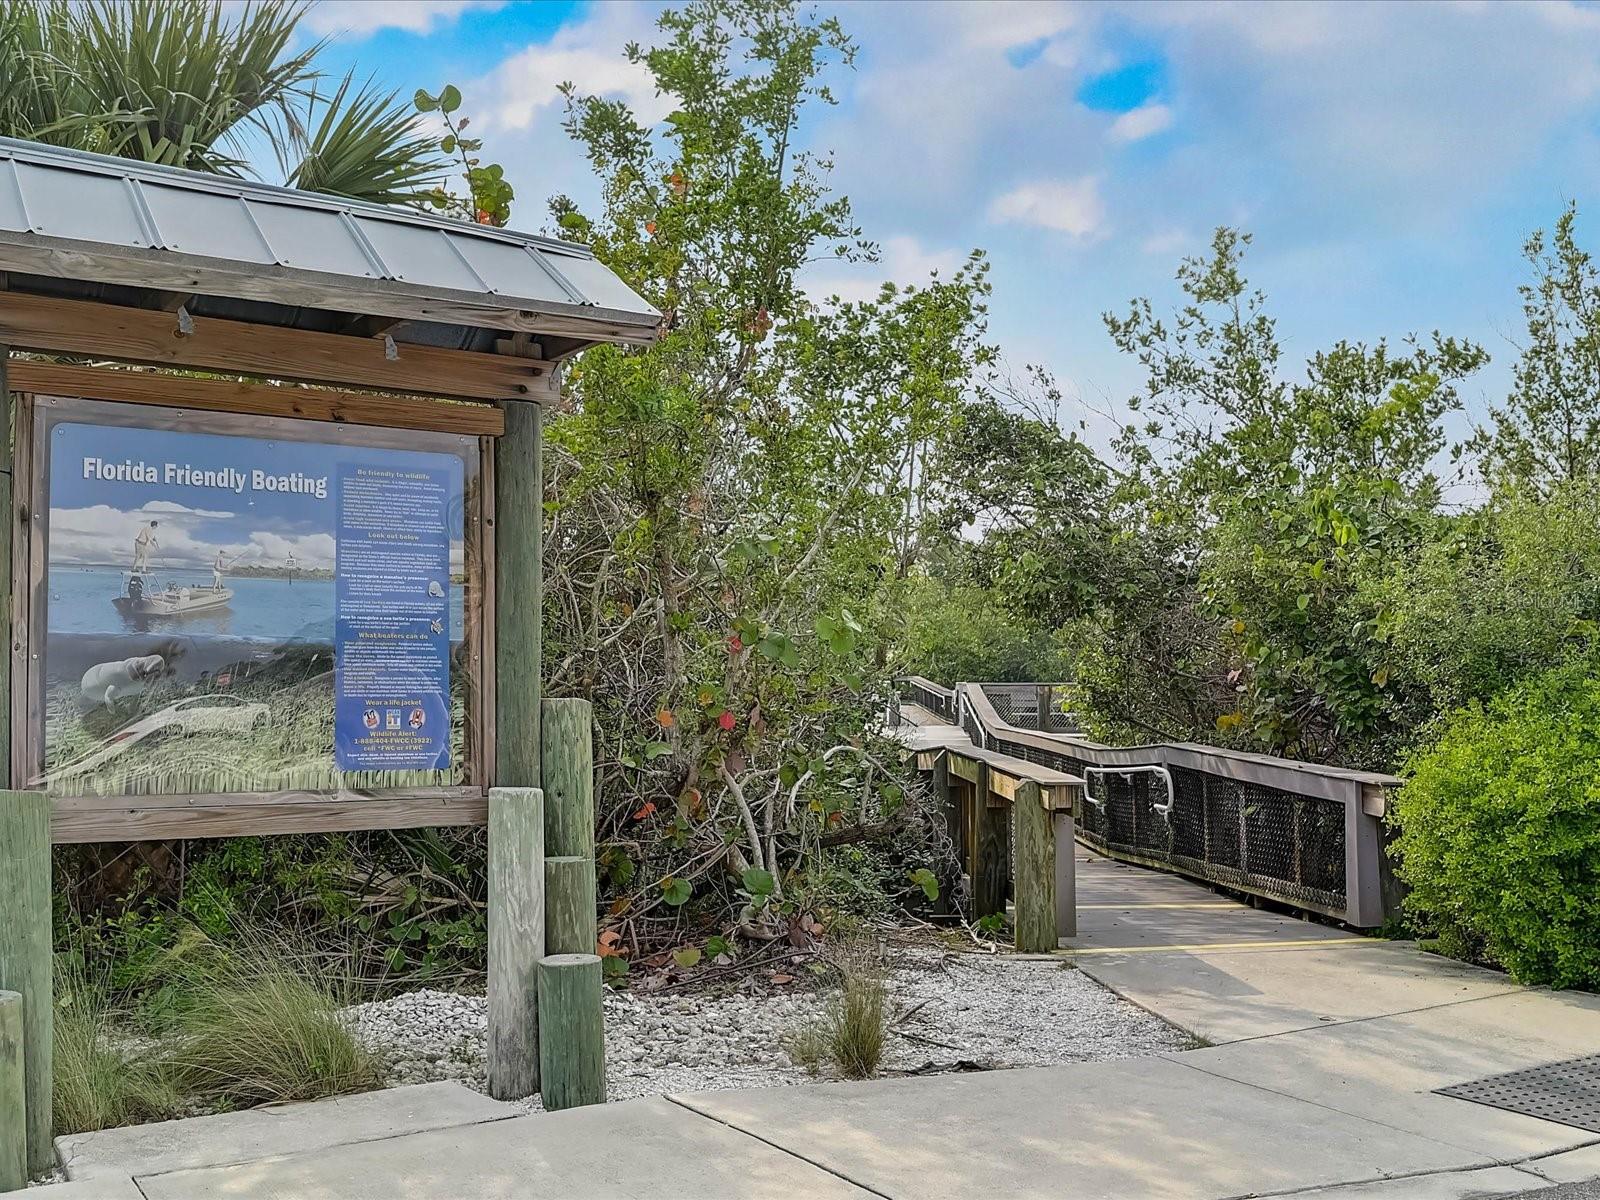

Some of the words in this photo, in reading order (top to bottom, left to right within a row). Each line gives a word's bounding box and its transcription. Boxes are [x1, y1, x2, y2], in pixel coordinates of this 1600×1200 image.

[83, 457, 158, 483] Florida
[164, 463, 246, 493] Friendly
[252, 469, 327, 499] Boating
[368, 470, 394, 478] friendly
